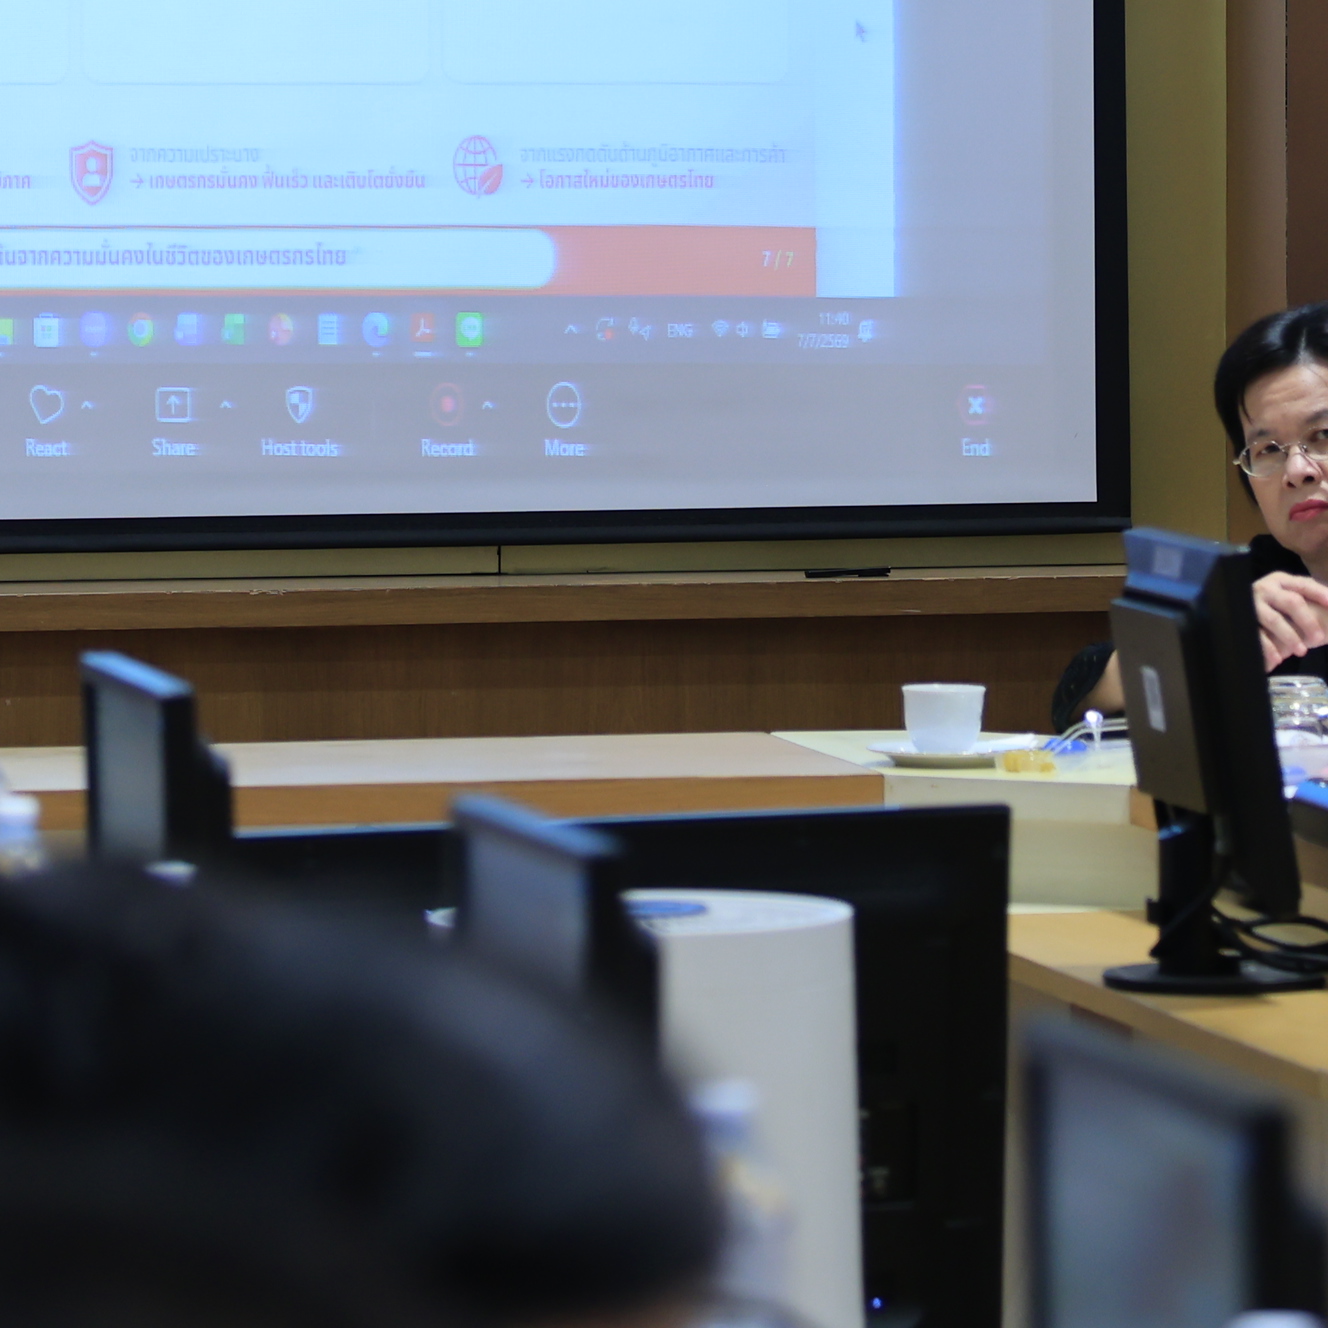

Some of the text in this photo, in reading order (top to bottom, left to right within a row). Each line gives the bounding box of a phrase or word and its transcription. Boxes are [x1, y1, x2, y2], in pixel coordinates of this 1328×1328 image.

[668, 323, 693, 338] ENG
[26, 439, 68, 457] React
[152, 439, 195, 457] Share
[261, 439, 338, 456] Host tools
[422, 439, 474, 457] Record
[545, 439, 585, 457] More
[961, 438, 991, 456] End
